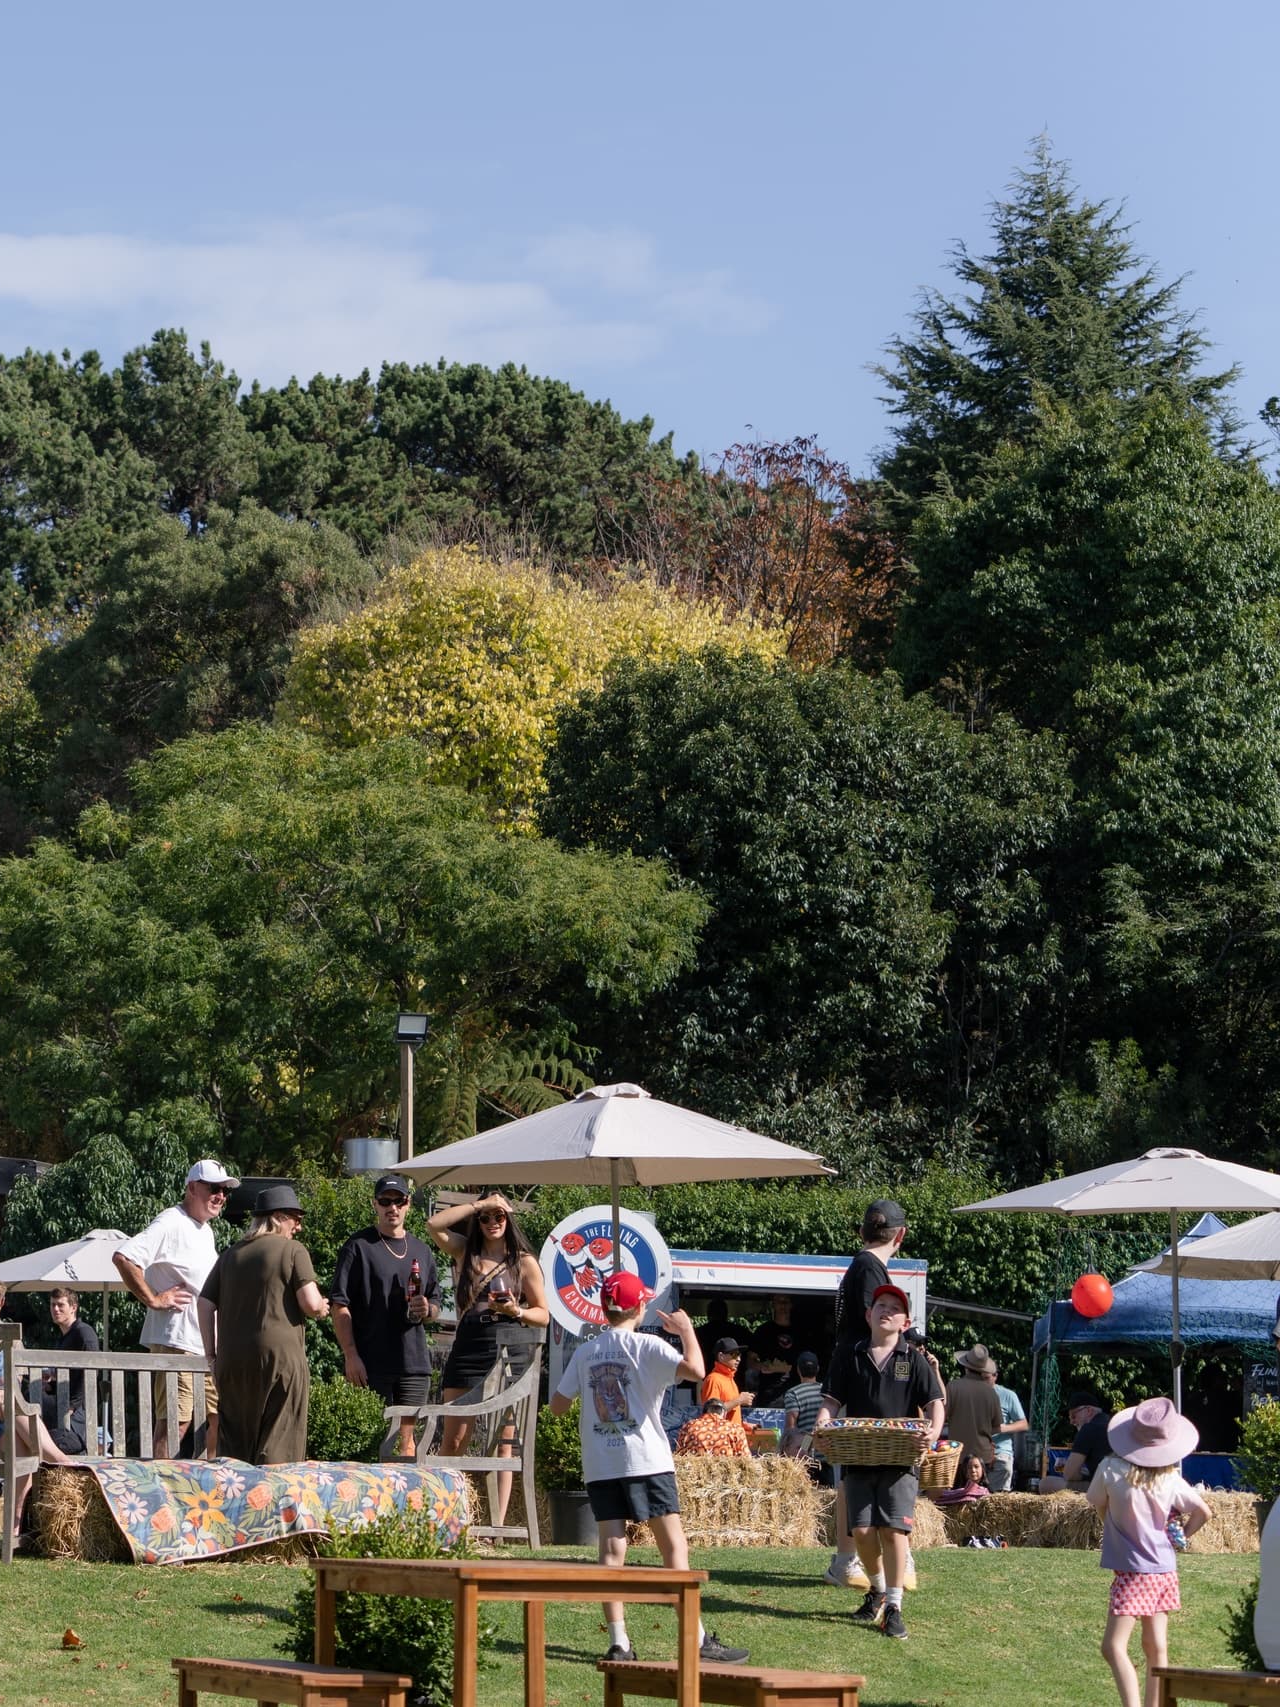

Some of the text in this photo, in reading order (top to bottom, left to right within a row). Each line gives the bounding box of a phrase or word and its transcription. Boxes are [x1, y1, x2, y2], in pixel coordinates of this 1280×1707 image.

[585, 1225, 640, 1249] THE FLING
[565, 1290, 606, 1321] CALAMA
